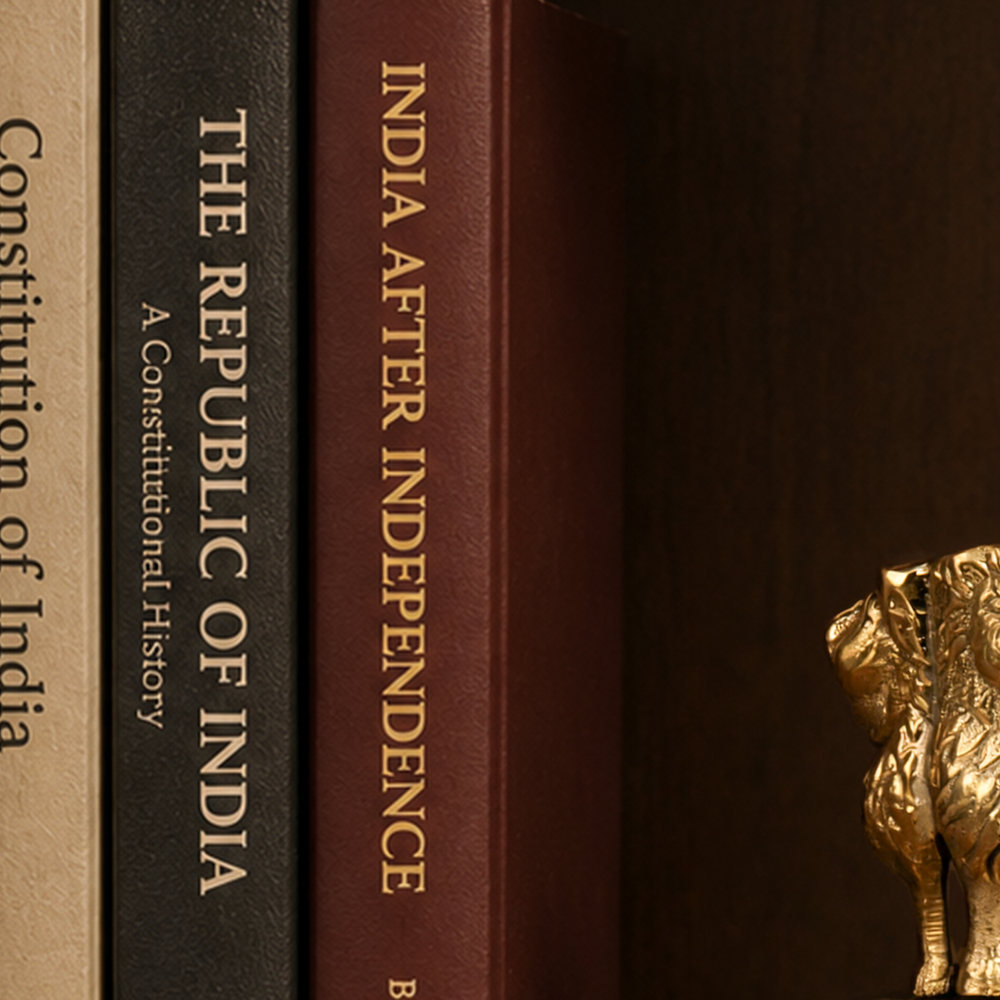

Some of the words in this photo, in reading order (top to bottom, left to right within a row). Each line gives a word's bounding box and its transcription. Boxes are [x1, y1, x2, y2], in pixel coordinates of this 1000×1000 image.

[200, 109, 247, 237] THE
[382, 61, 426, 228] INDIA
[0, 117, 43, 490] Constitution
[141, 302, 171, 332] A
[382, 243, 426, 431] AFTER
[200, 262, 247, 579] REPUBLIC
[0, 516, 44, 580] of
[0, 599, 44, 753] India
[136, 600, 171, 729] History
[200, 602, 247, 687] OF
[382, 448, 426, 894] INDEPENDENCE
[200, 708, 247, 896] INDIA
